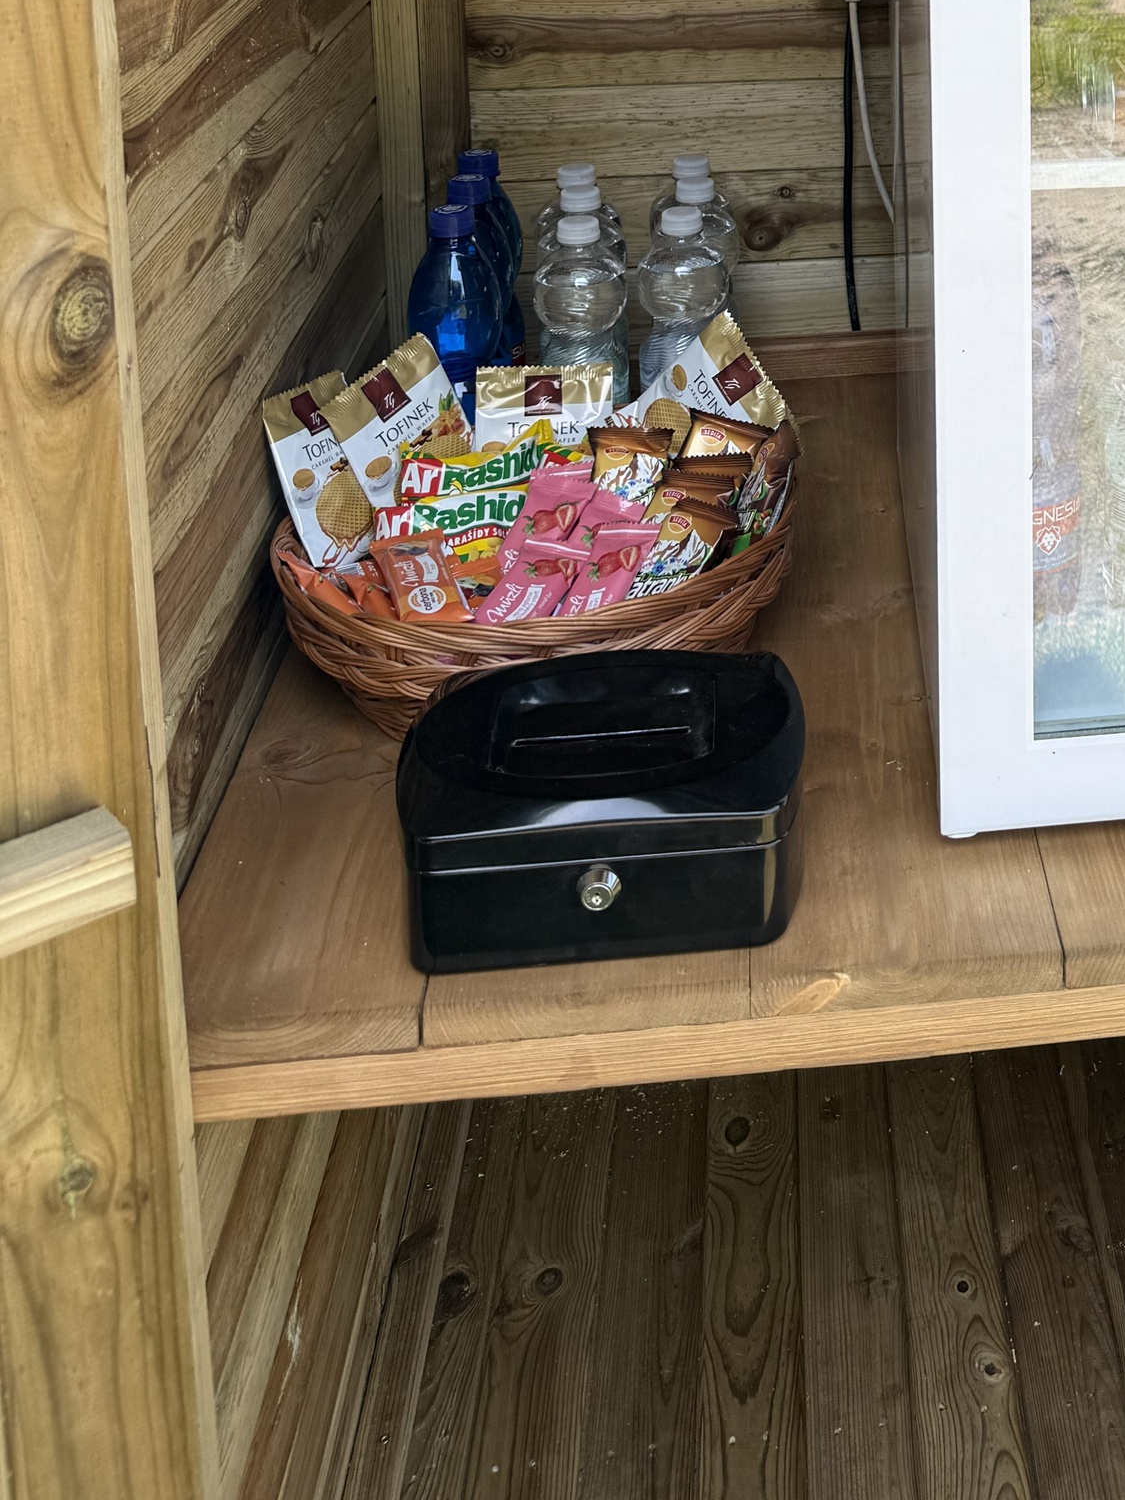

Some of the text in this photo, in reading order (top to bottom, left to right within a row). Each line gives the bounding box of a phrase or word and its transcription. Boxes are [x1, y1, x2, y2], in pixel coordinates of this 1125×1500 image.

[693, 368, 728, 417] TOFIN
[374, 396, 435, 448] TOFINEK
[416, 413, 436, 432] WAFER
[507, 420, 580, 438] TONEK
[302, 437, 338, 462] TOFIN
[311, 455, 335, 471] CARAMEL
[671, 515, 690, 529] SEDITA
[1032, 497, 1081, 525] GNESIA
[448, 527, 490, 548] ARAŠÍDY
[626, 573, 688, 600] atrank
[419, 587, 434, 612] cerbona
[486, 582, 525, 624] Müzli
